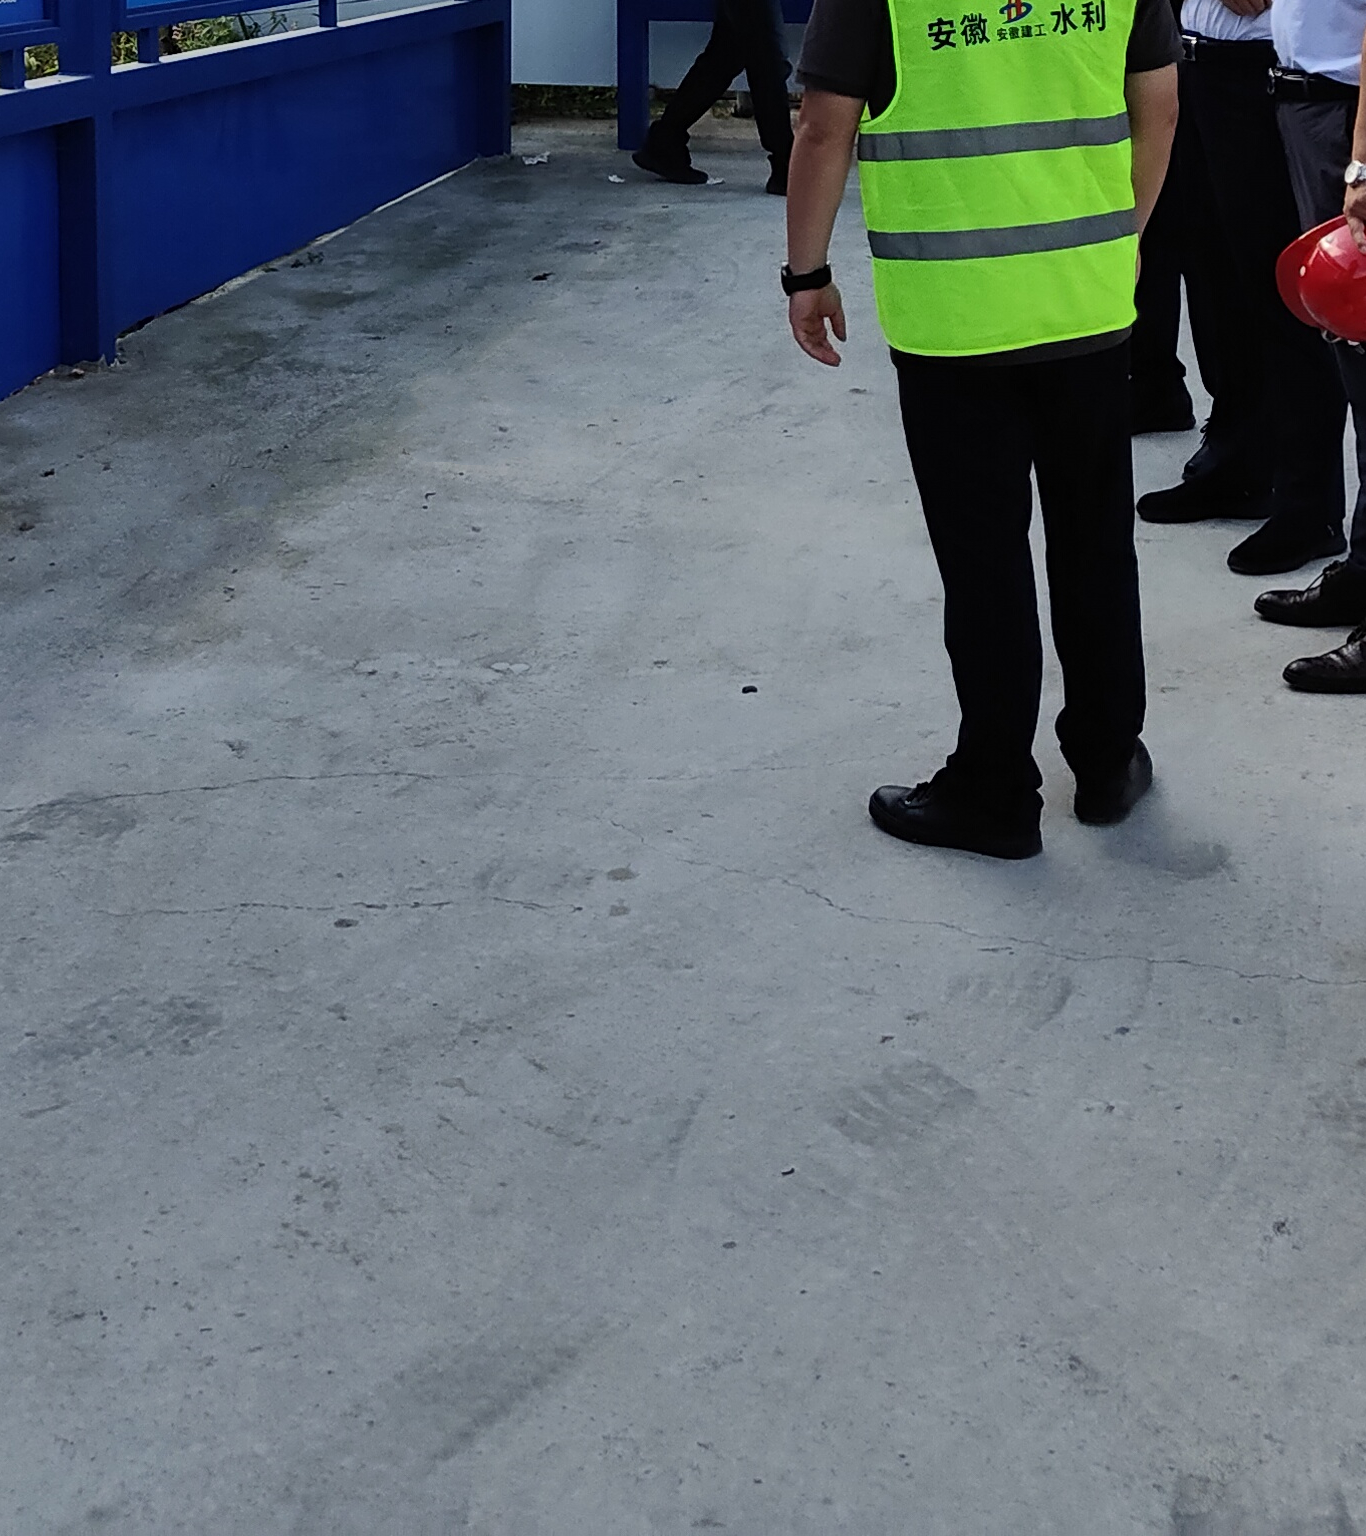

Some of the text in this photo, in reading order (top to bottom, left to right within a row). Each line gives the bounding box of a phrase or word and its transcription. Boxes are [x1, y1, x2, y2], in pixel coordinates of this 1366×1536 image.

[927, 0, 1107, 52] 安徽 水利
[996, 23, 1048, 42] 安徽建工
